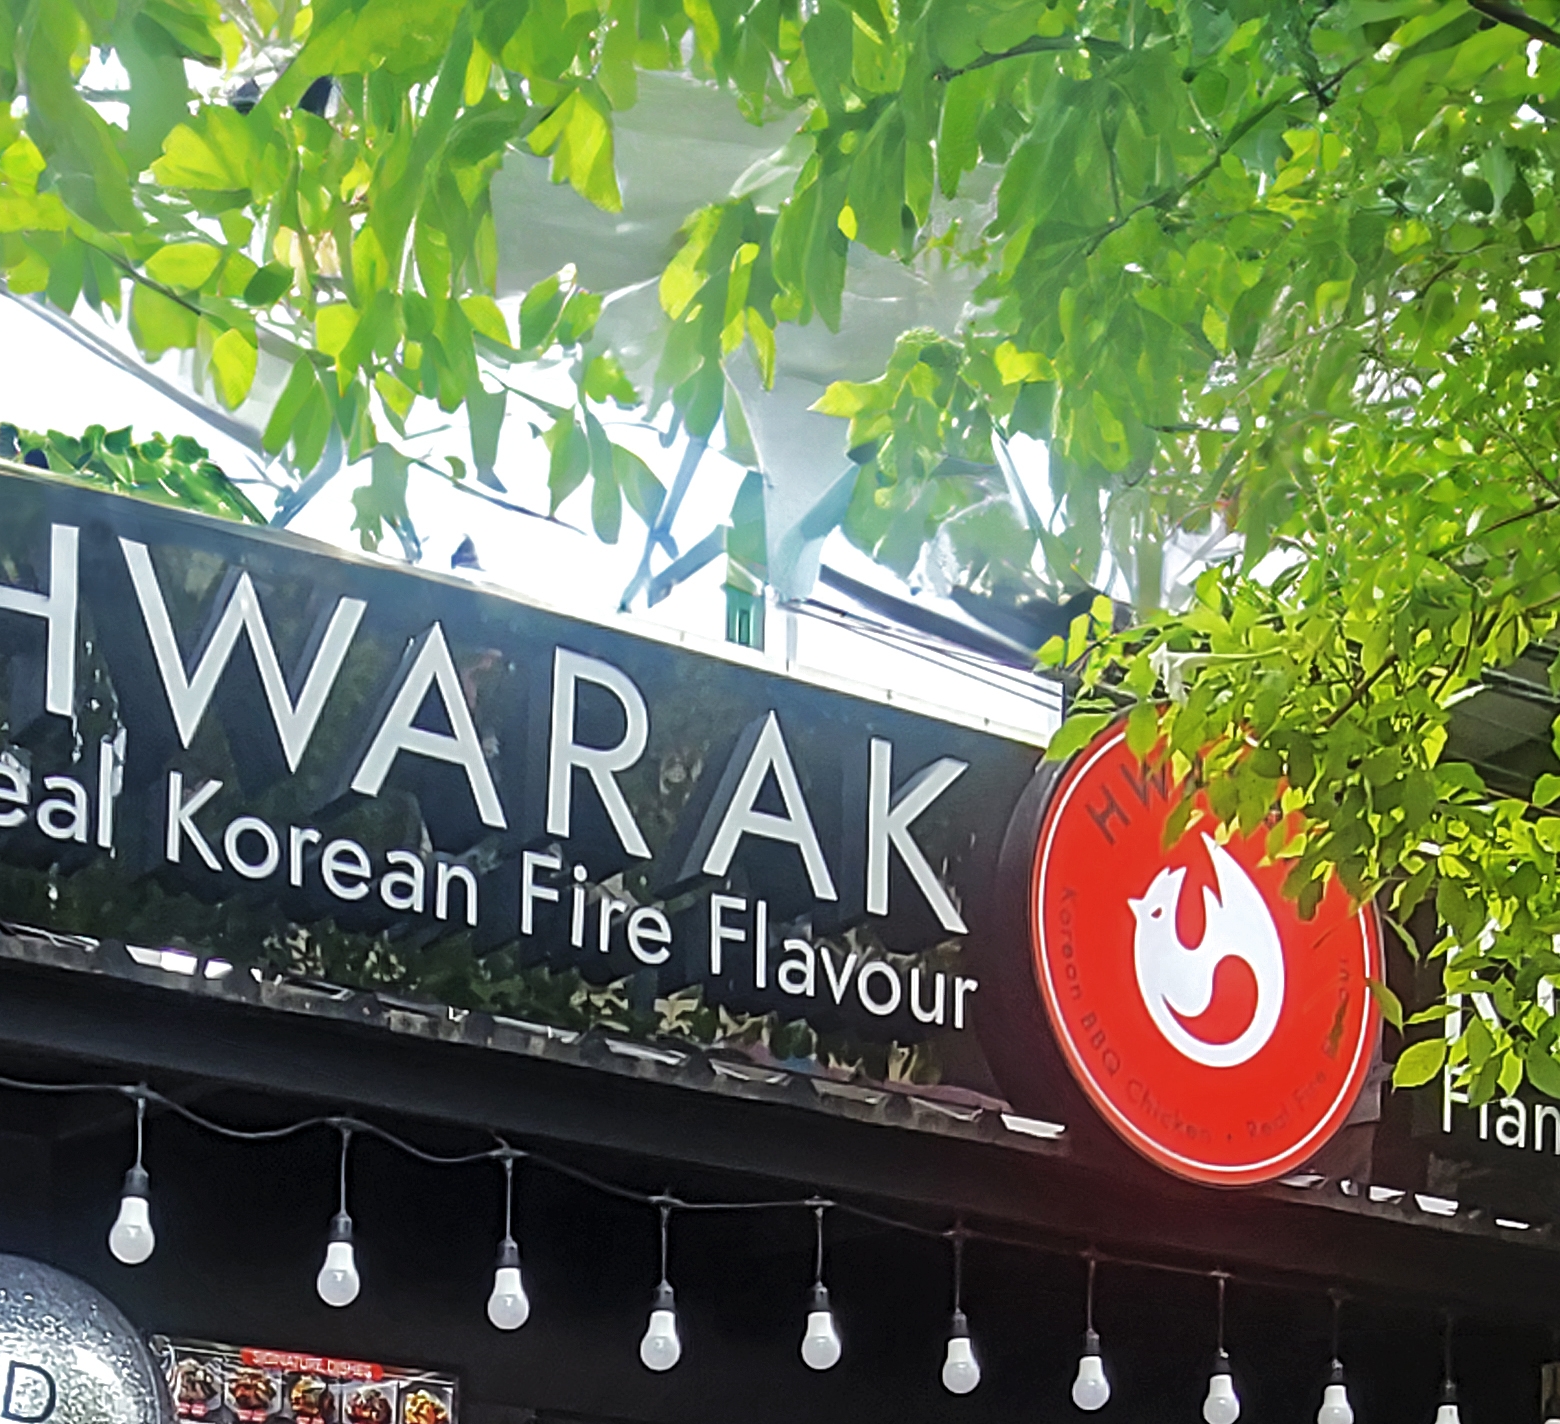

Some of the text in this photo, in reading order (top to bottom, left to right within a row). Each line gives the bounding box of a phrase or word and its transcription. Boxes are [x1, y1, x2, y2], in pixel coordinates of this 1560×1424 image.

[166, 771, 479, 929] Korean
[520, 850, 674, 967] Fire
[709, 894, 981, 1031] Flavour
[1080, 1011, 1121, 1078] BBQ
